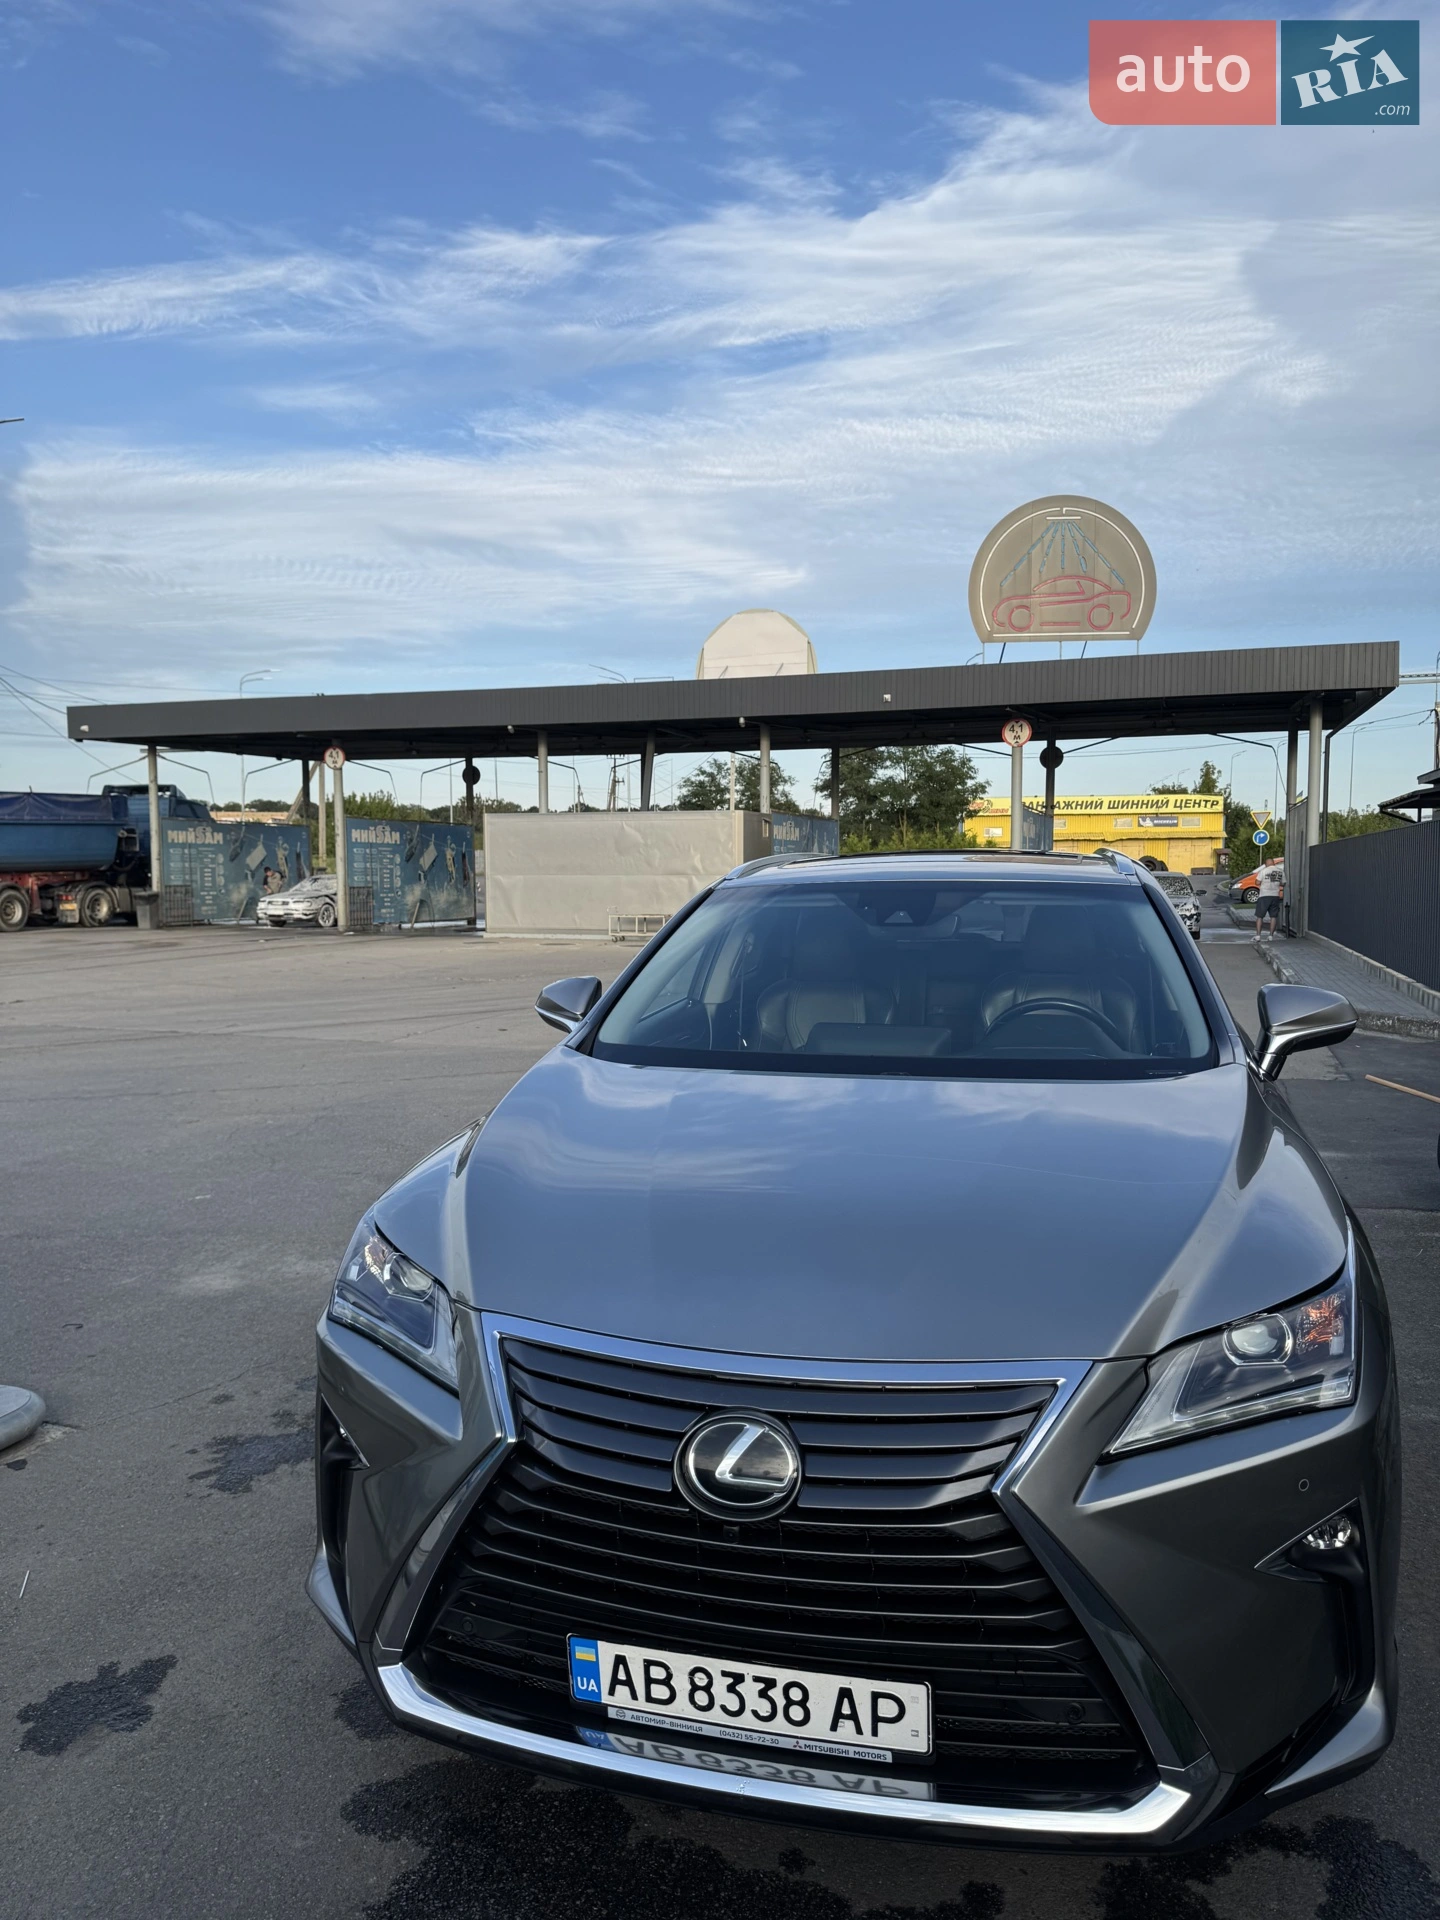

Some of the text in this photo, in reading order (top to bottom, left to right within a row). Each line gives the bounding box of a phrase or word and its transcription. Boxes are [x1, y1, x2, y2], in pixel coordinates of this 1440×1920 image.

[1107, 797, 1169, 810] ШИННИЙ
[1173, 798, 1219, 811] ЦЕНТР
[577, 1676, 598, 1692] UA
[608, 1653, 906, 1738] AB 8338 AP
[630, 1713, 780, 1746] АВТОМИР-ВІННИЦЯ (0432) 55-72-30
[803, 1743, 888, 1761] MITSUBISHI MOTORS
